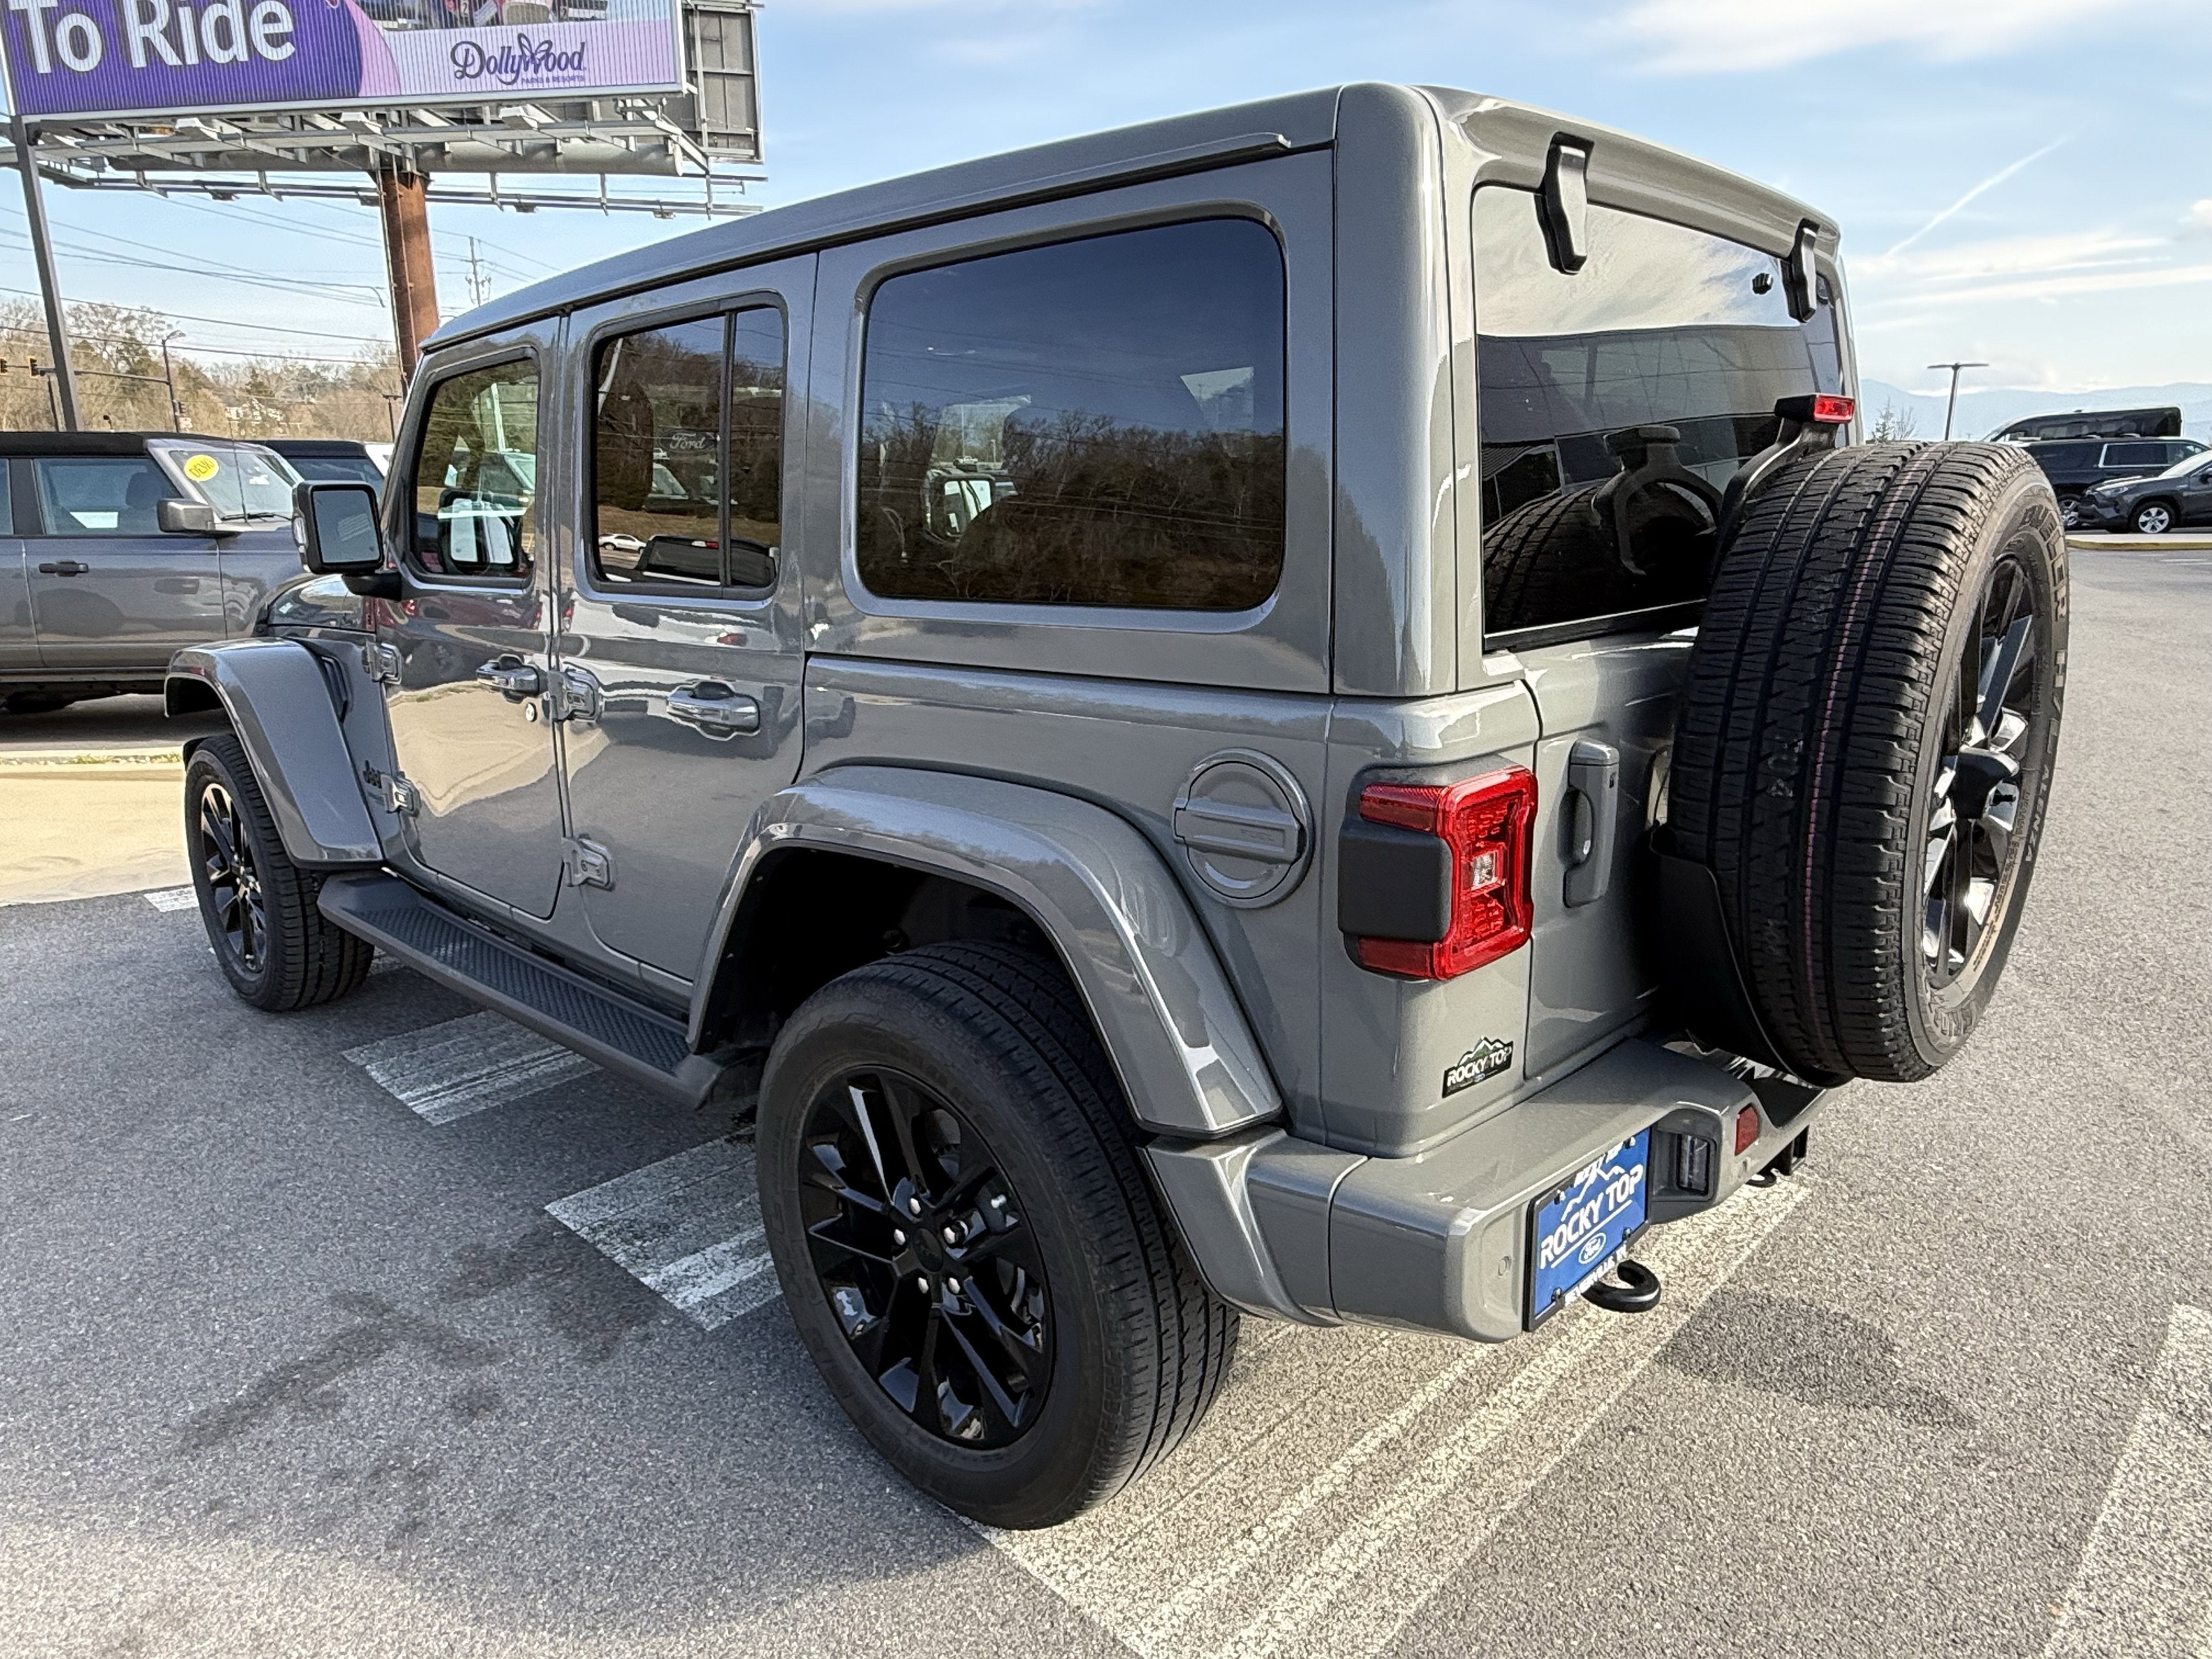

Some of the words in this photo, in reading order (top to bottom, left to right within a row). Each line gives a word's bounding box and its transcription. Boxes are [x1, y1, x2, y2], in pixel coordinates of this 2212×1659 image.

[9, 0, 103, 74] To
[121, 0, 296, 68] Ride
[669, 432, 706, 449] Ford
[1447, 1057, 1488, 1087] ROCKY
[1489, 1046, 1513, 1068] TOP
[1540, 1191, 1604, 1269] ROCKY
[1605, 1164, 1644, 1212] TOP
